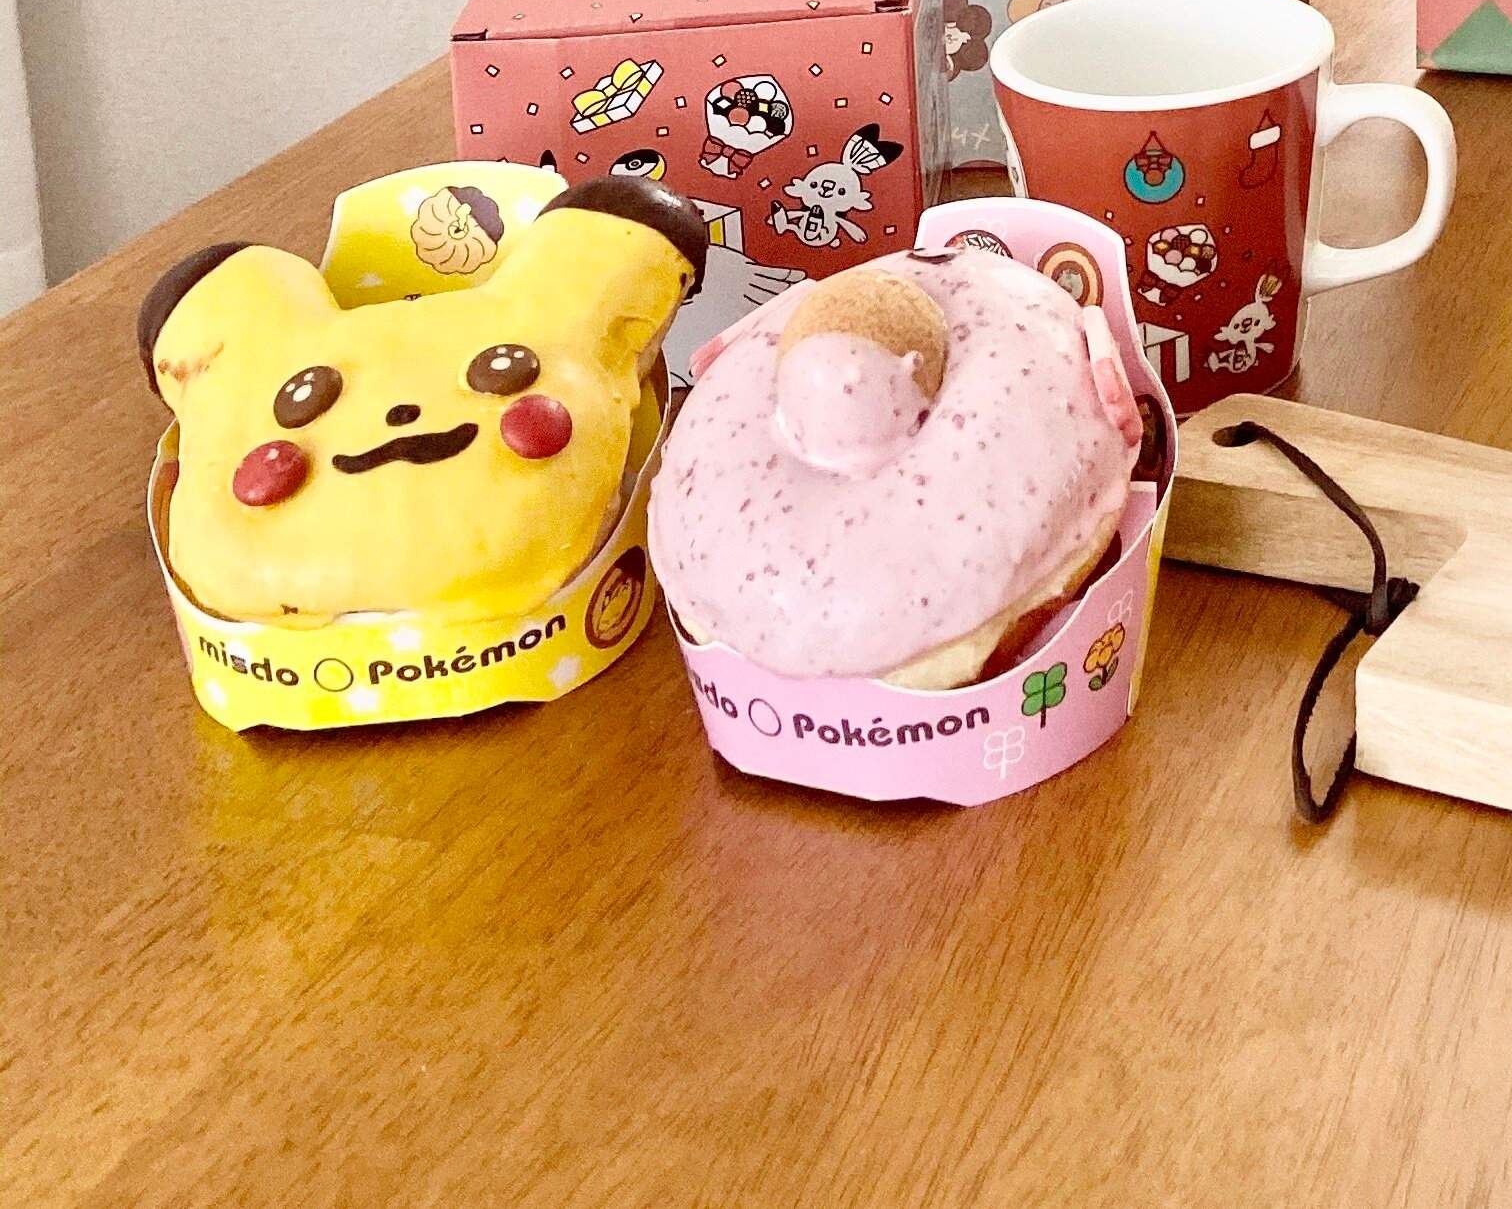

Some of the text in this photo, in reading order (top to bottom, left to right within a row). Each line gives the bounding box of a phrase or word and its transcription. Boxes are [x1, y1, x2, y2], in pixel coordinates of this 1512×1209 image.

[198, 612, 567, 687] misdo Pokémon
[792, 705, 990, 748] Pokémon
